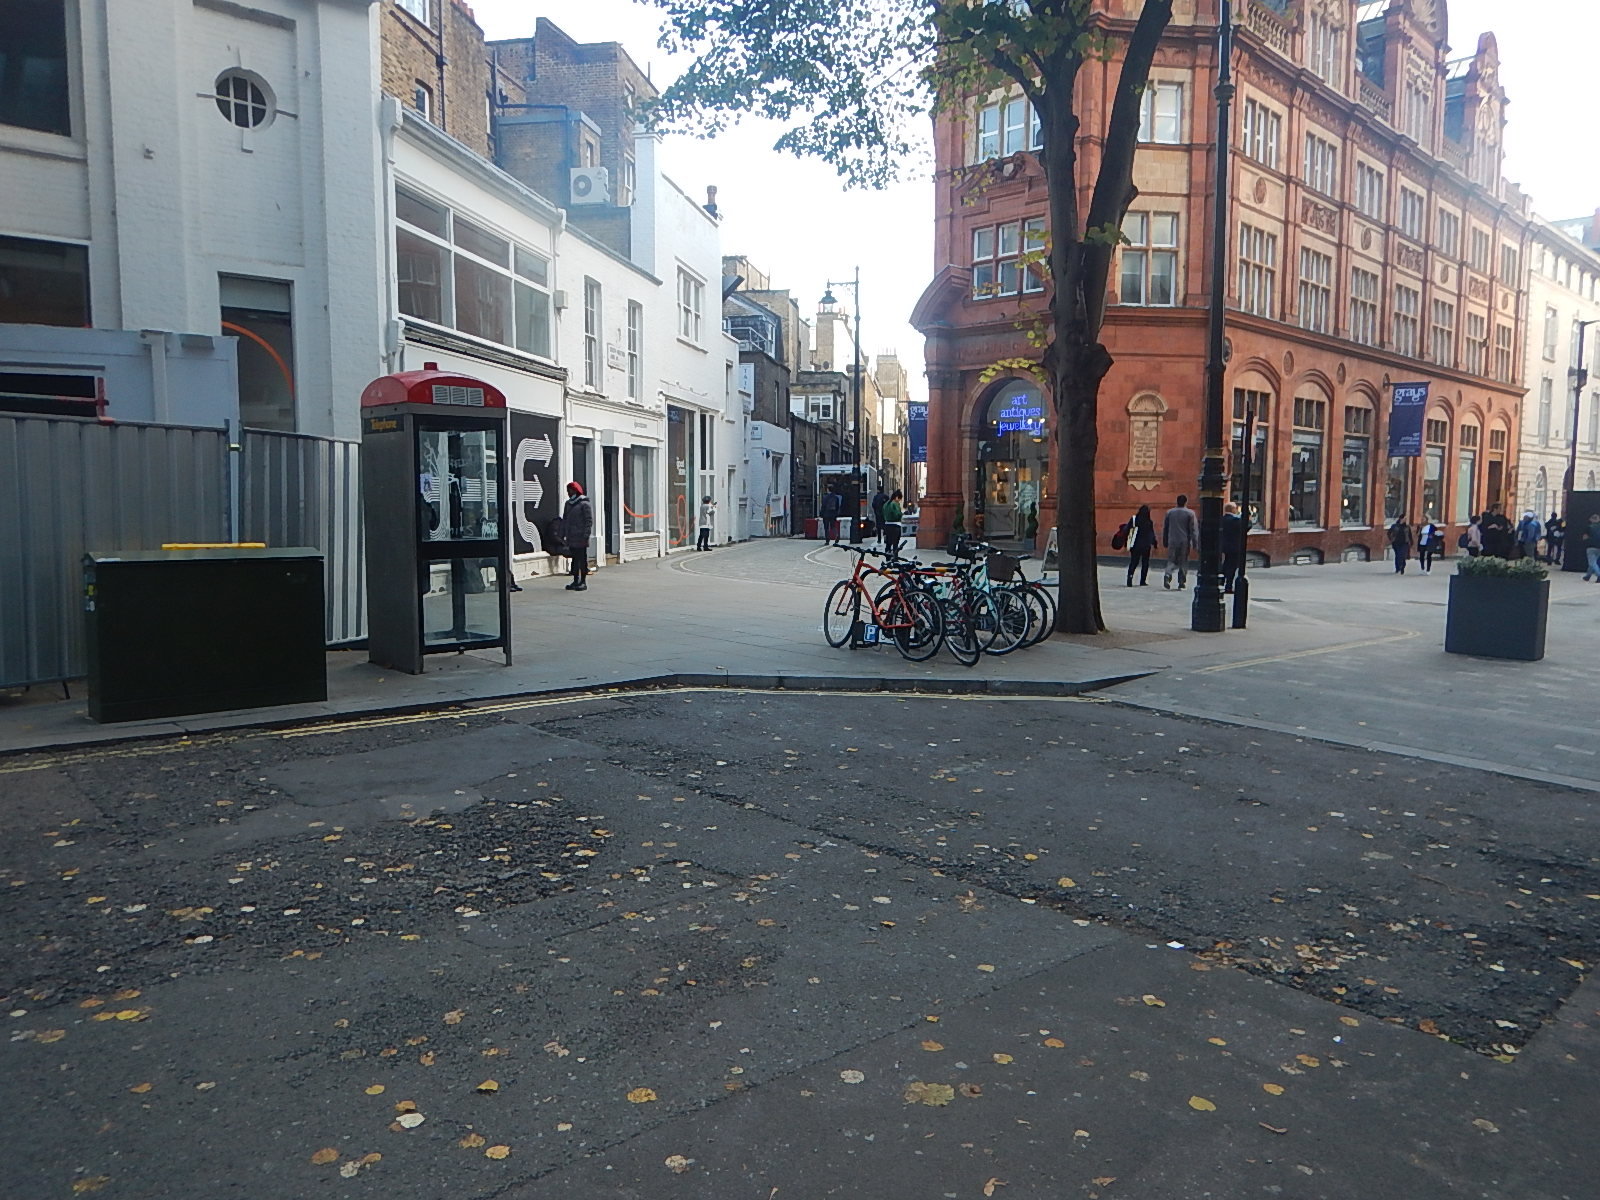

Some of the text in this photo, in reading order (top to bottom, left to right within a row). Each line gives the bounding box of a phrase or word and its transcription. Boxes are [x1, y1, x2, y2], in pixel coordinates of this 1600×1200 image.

[1011, 394, 1028, 405] art
[1394, 387, 1426, 402] grays
[1000, 407, 1041, 424] antiques
[371, 418, 397, 431] Telephone
[997, 420, 1041, 437] jewellery
[866, 626, 876, 640] P
